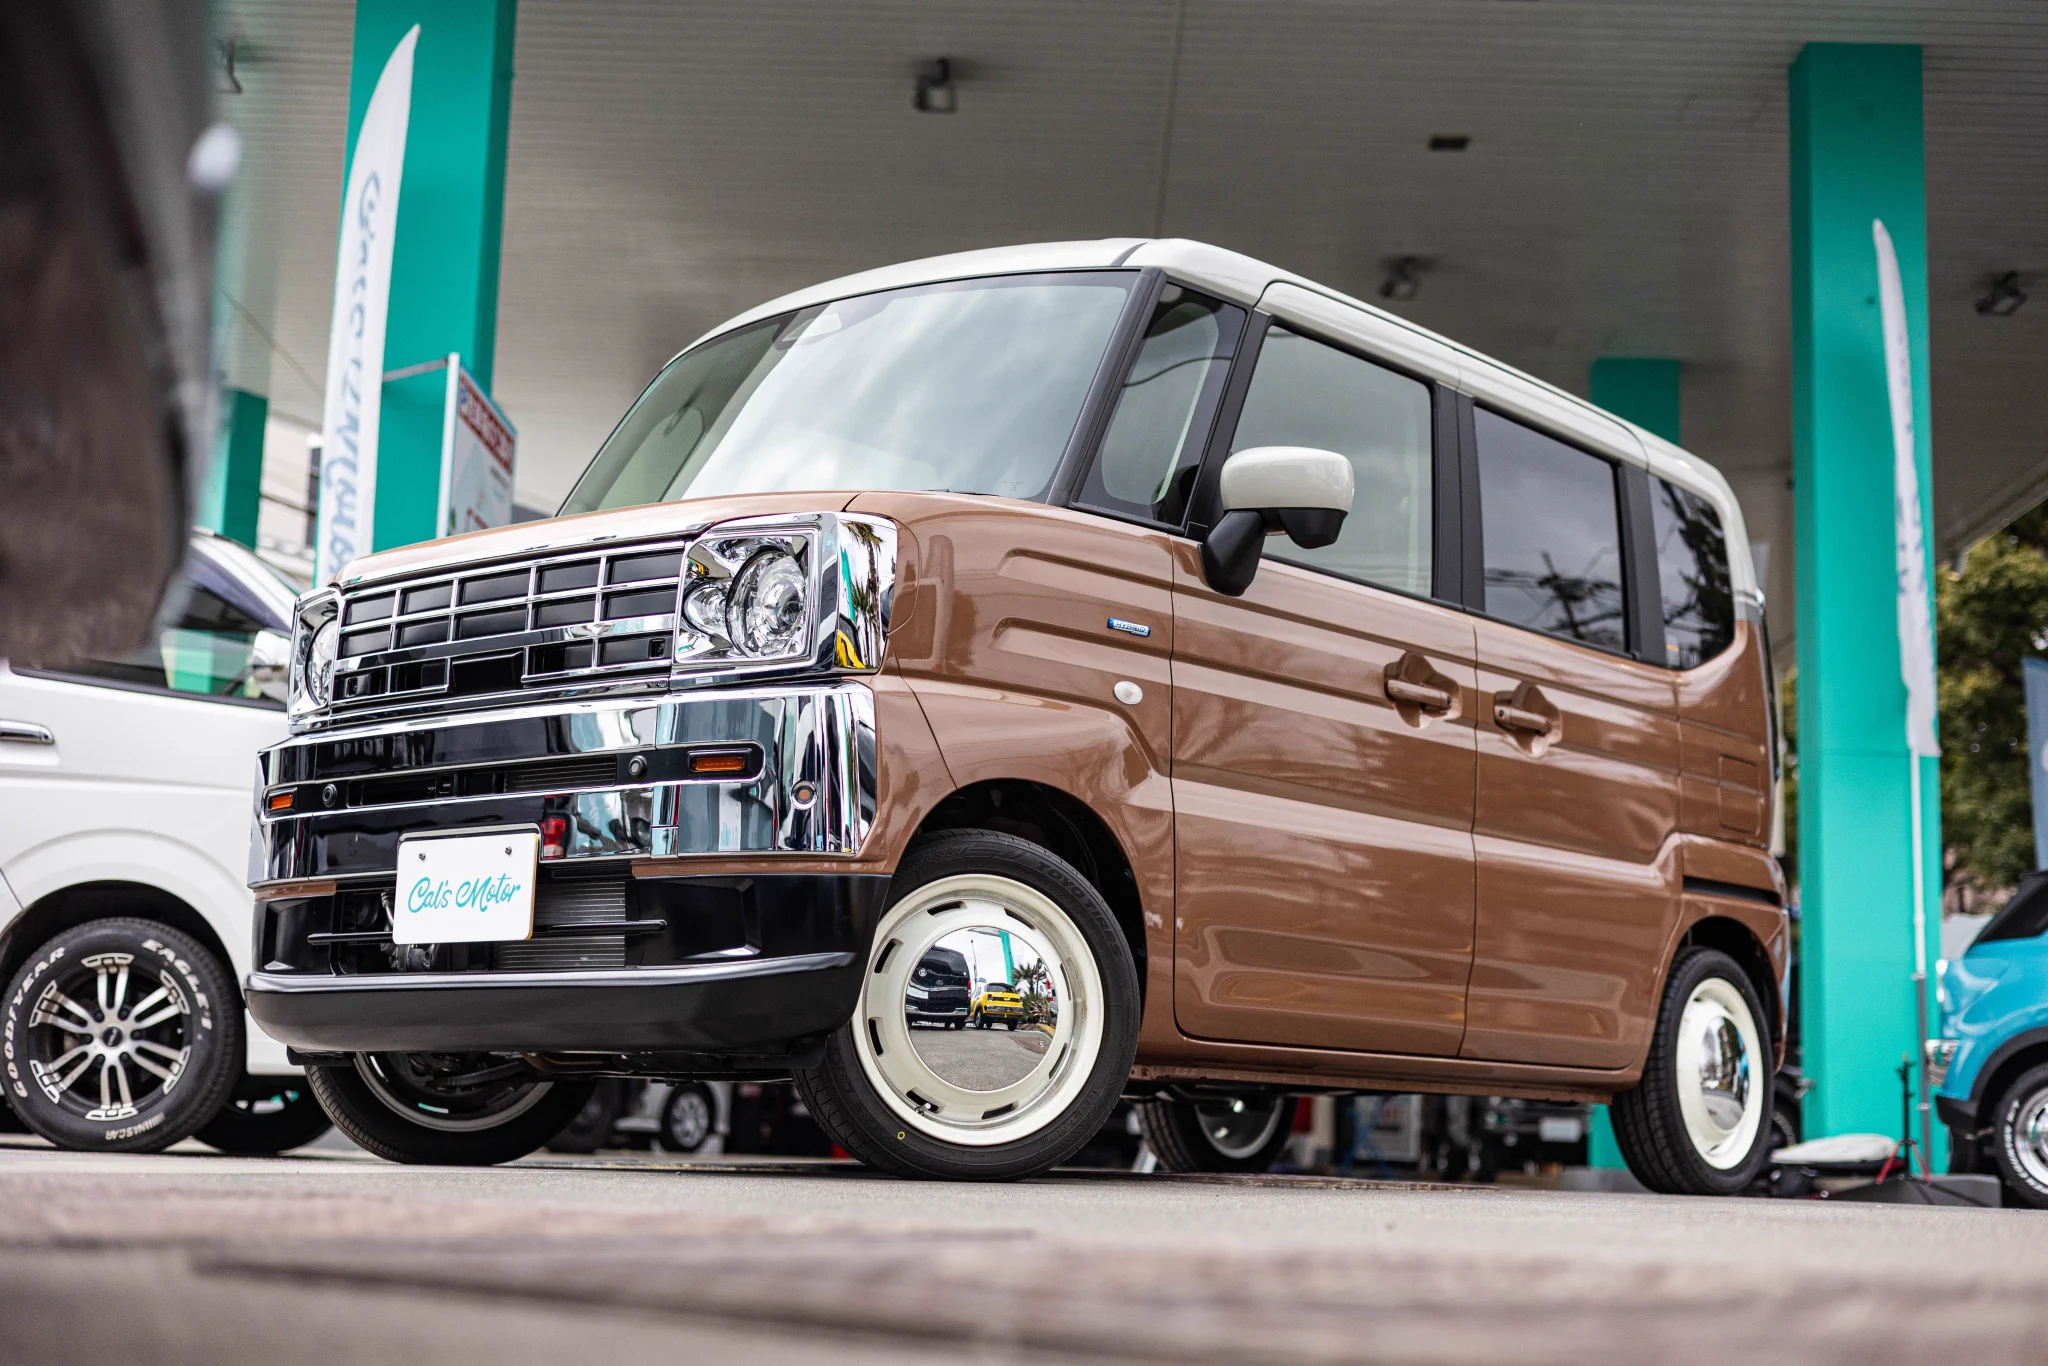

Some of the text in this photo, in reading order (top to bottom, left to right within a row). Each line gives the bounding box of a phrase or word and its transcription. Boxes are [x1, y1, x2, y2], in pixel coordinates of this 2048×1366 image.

[1115, 620, 1147, 633] HYBRID
[407, 873, 521, 913] Cal's Motor
[1038, 861, 1086, 899] TOYO
[1084, 902, 1123, 958] TIRES
[5, 947, 66, 1098] GOODYEAR
[105, 1118, 150, 1141] NASCAR
